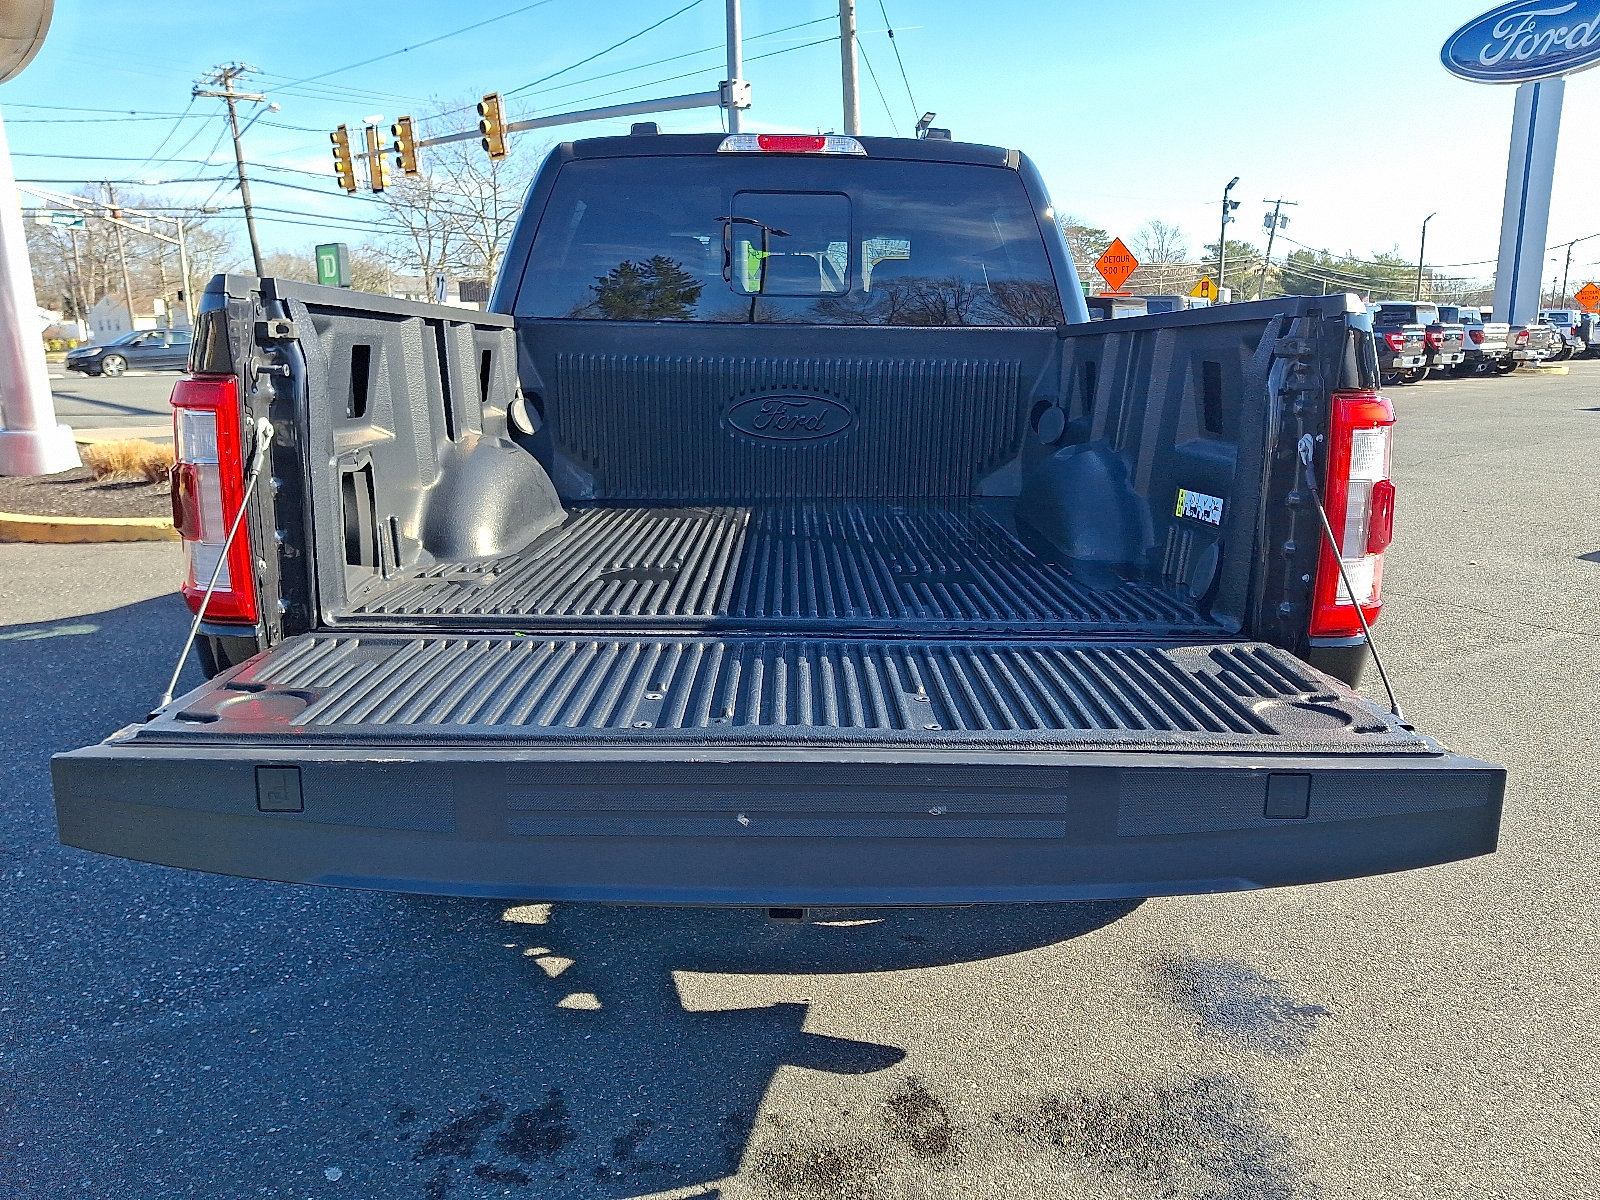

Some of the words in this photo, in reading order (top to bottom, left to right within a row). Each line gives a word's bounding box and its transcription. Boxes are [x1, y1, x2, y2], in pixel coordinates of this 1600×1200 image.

[1479, 2, 1600, 66] Ford
[1103, 254, 1130, 264] DETOUR
[1103, 266, 1118, 275] 500
[1121, 265, 1130, 274] FT
[753, 400, 829, 431] Ford
